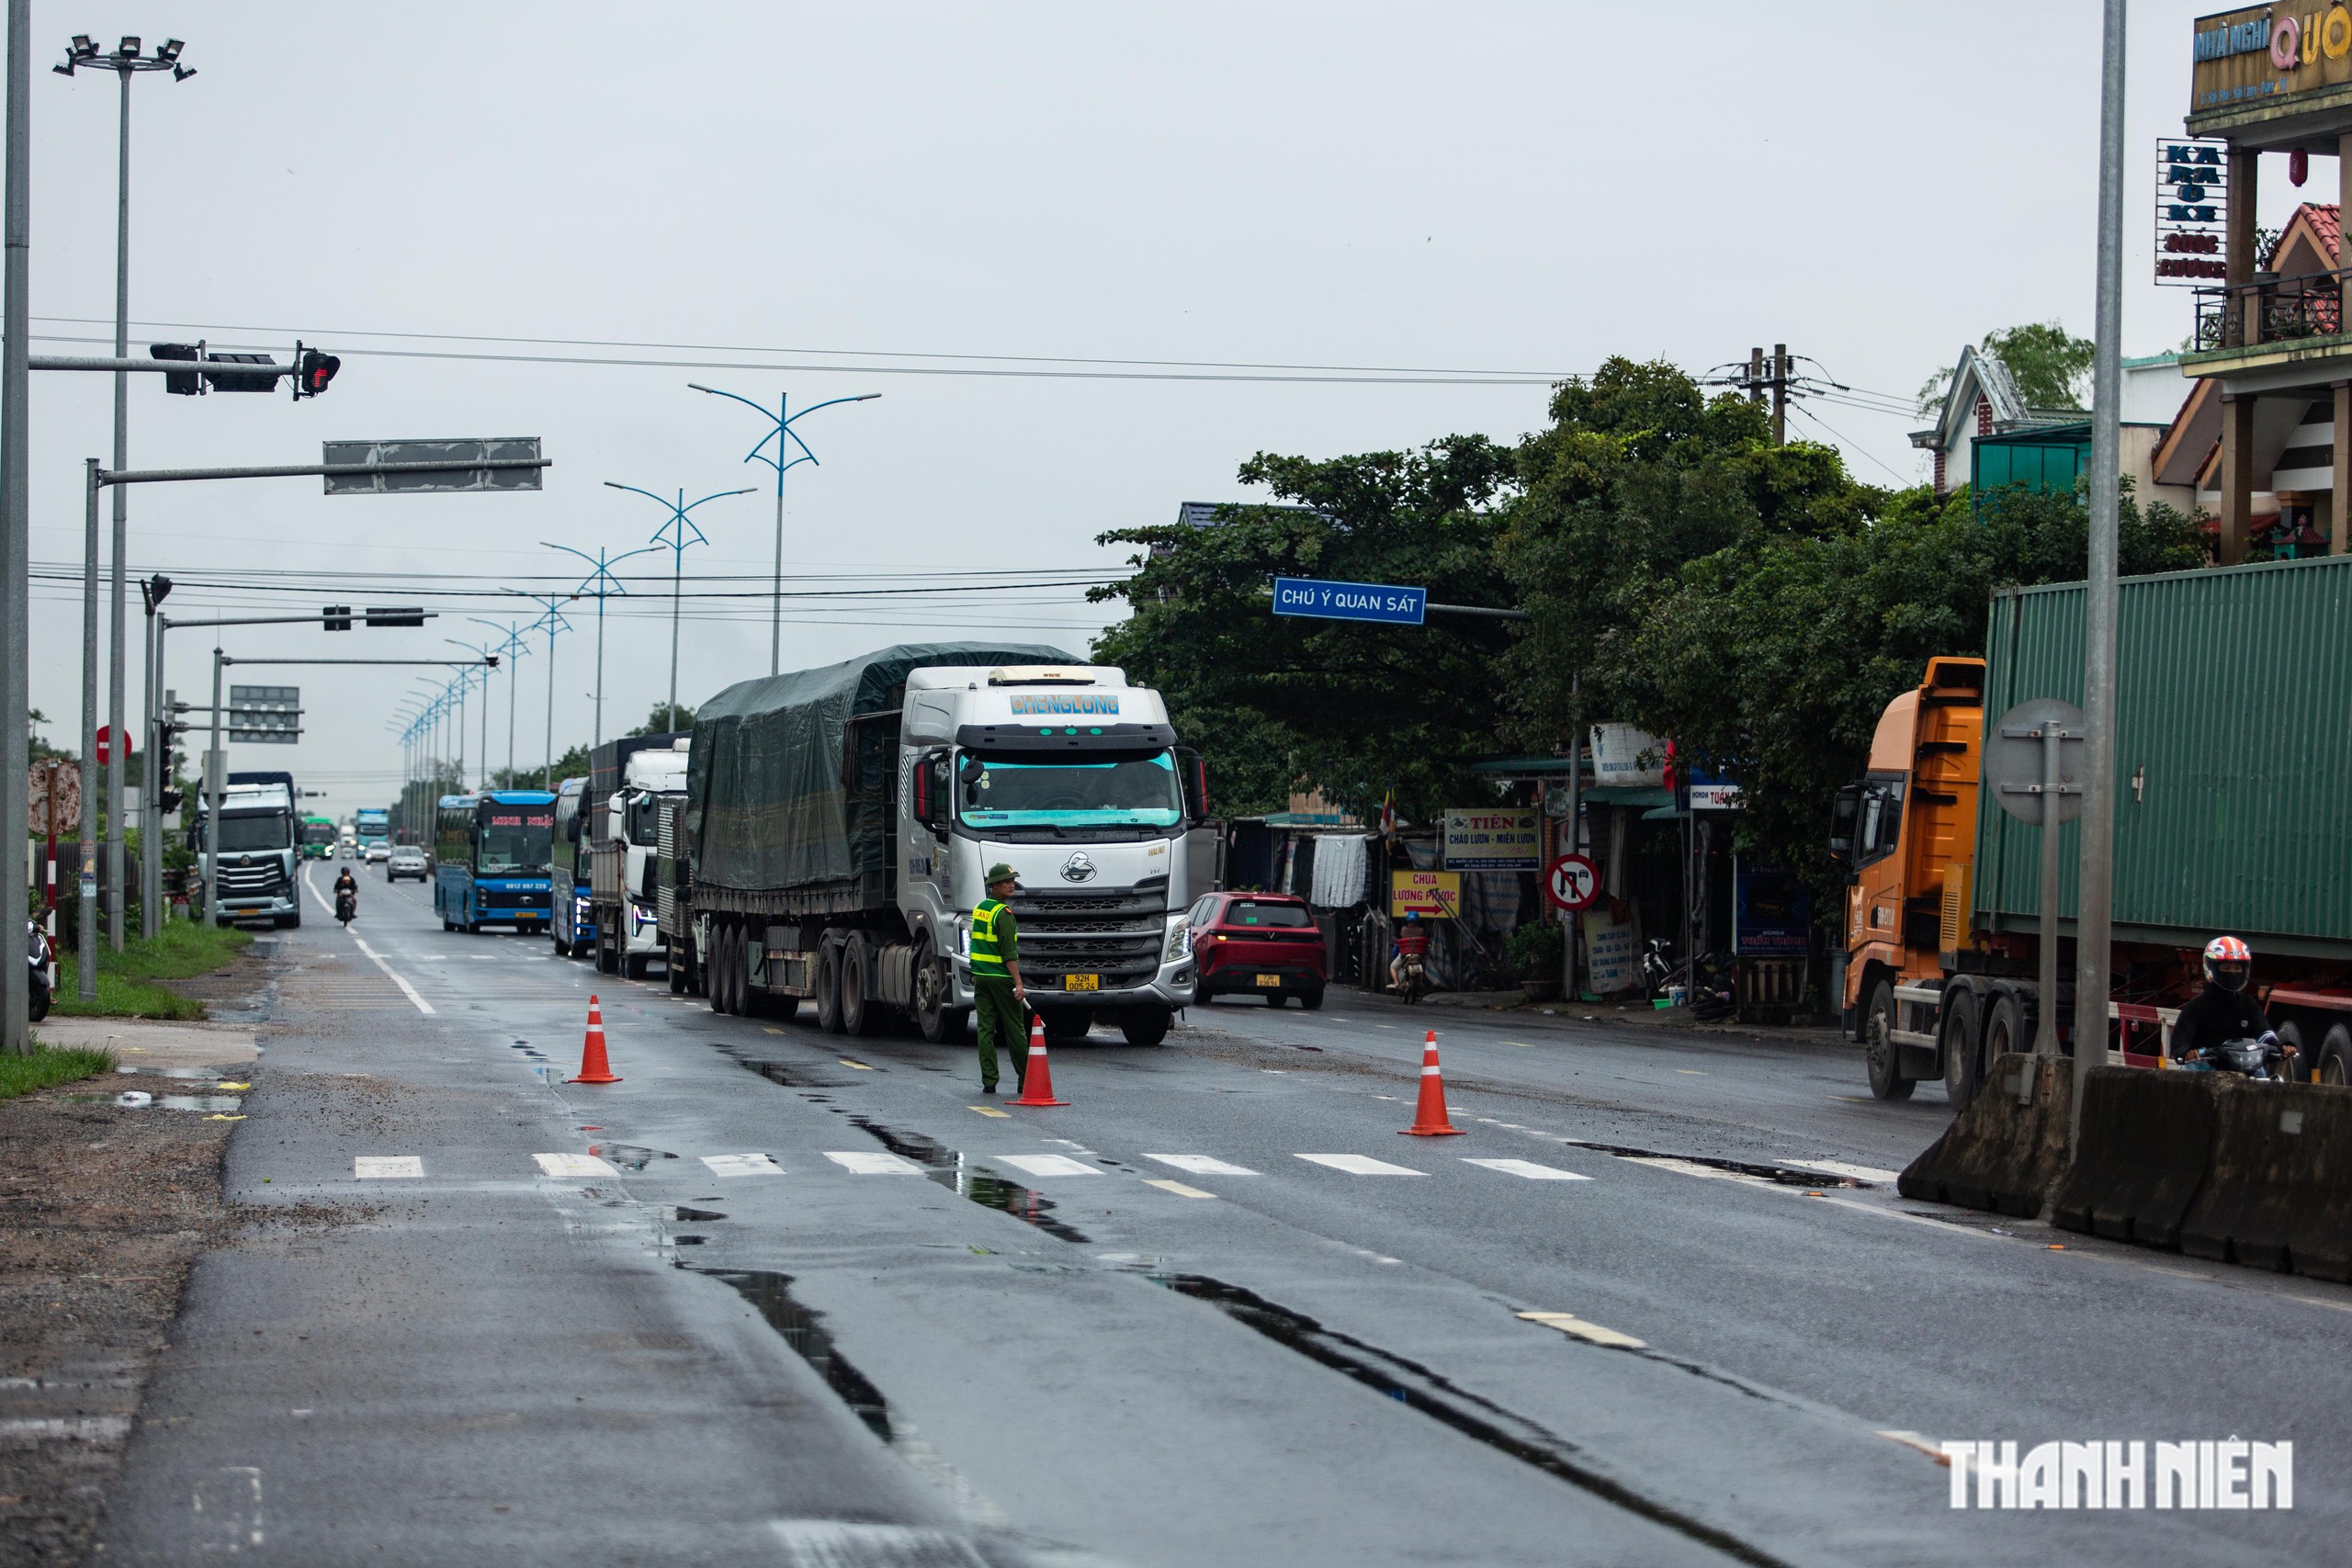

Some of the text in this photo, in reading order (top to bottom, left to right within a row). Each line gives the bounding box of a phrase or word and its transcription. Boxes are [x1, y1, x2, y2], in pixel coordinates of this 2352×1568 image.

[2194, 20, 2229, 62] NHÀ
[2166, 145, 2221, 164] KA
[2177, 185, 2205, 202] O
[2167, 204, 2217, 222] KE
[1283, 588, 1417, 612] CHÚ Ý QUAN SÁT
[1011, 695, 1119, 715] CHENGLONG
[1691, 791, 1709, 799] HONDA
[492, 816, 521, 826] MINH
[1449, 832, 1468, 844] CHÁO
[1393, 889, 1423, 900] LƯƠNG
[1075, 975, 1090, 983] 92H
